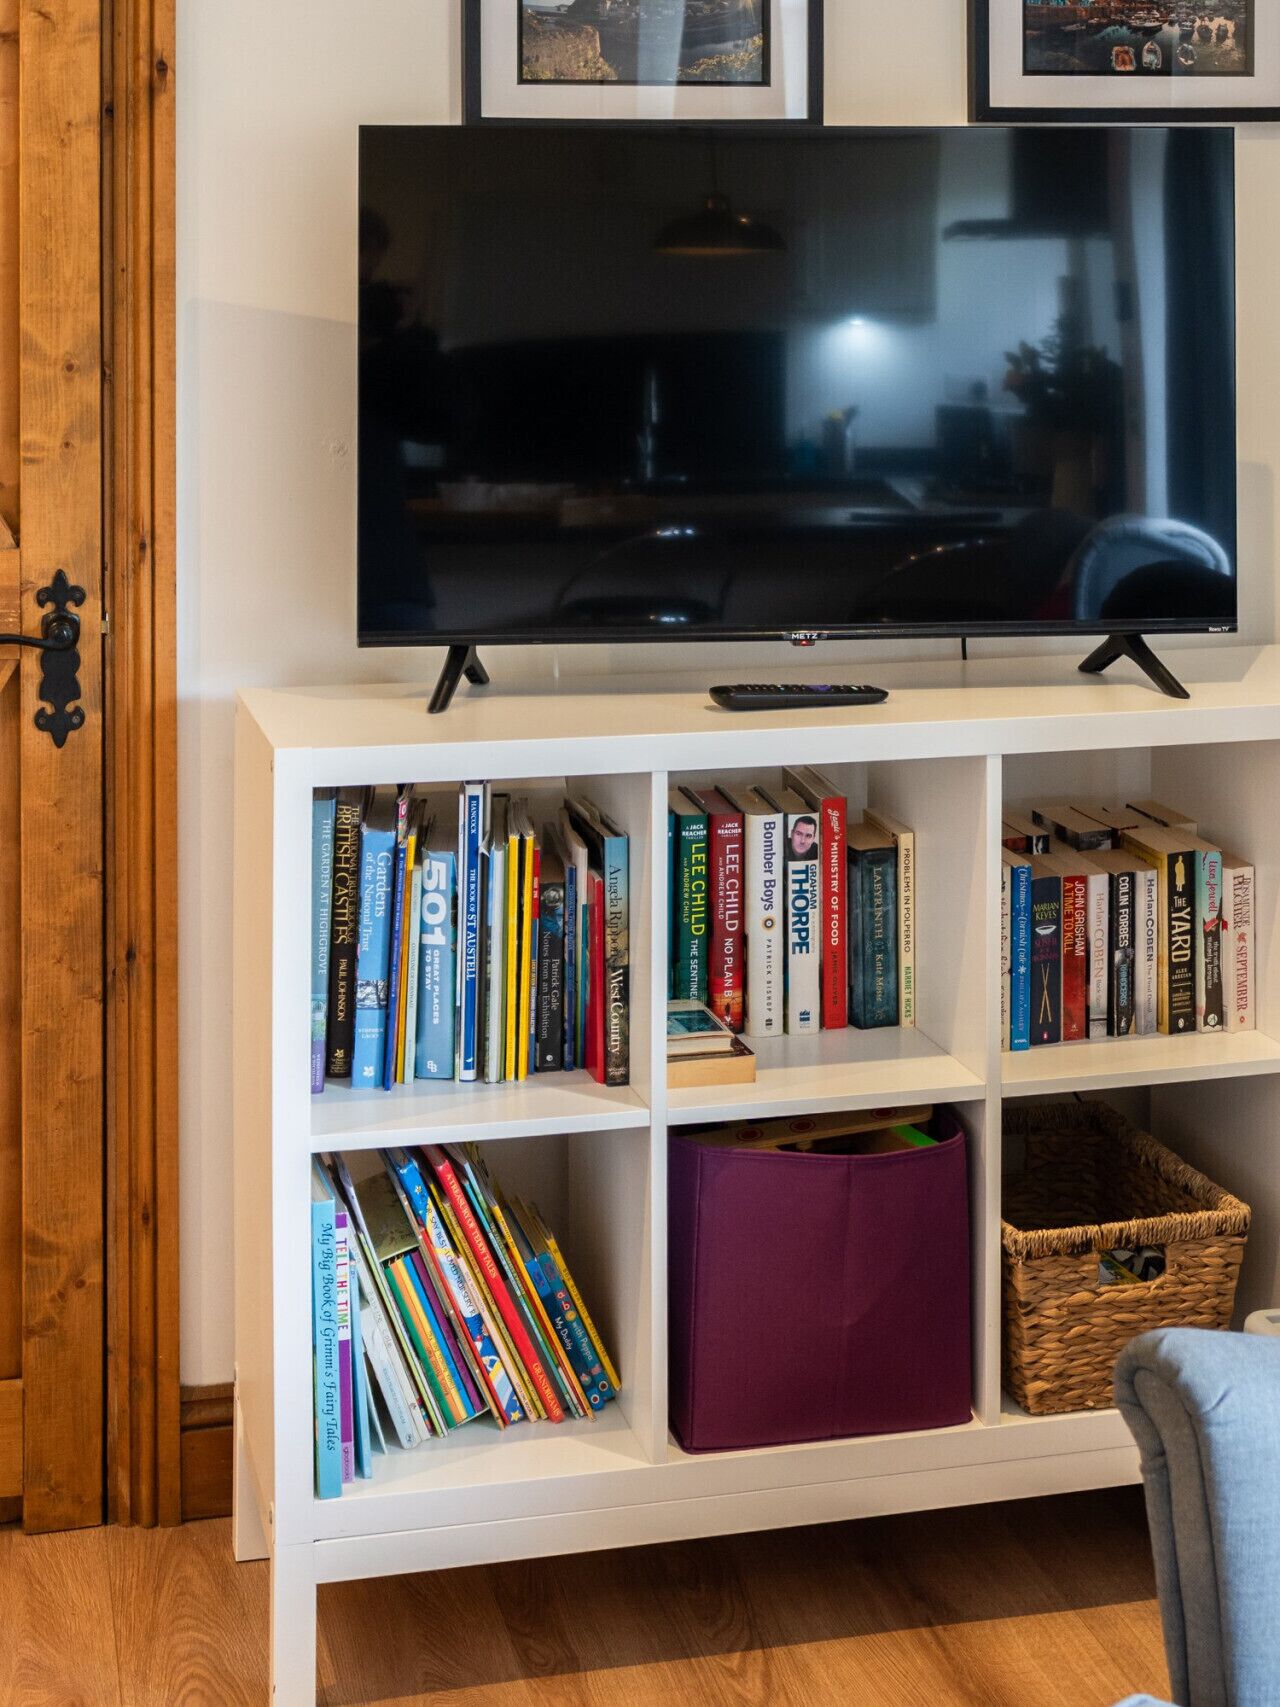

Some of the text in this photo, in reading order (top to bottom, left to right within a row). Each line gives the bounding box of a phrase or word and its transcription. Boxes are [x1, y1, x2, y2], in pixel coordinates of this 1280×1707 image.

[791, 632, 817, 640] METZ
[350, 806, 360, 825] THE
[828, 808, 842, 841] Jamie's
[334, 805, 351, 945] BRITISH CASTLES
[374, 852, 394, 918] Gardens
[608, 864, 622, 909] Angela
[690, 842, 706, 937] LEE CHILD
[725, 843, 739, 933] LEE CHILD
[759, 820, 776, 913] Bomber Boys
[809, 863, 818, 910] GRAHAM
[830, 842, 840, 892] MINISTRY
[1018, 868, 1028, 907] Christmas
[317, 819, 331, 975] THE GARDEN AT HIGHGROVE
[361, 852, 376, 952] of the National Trust
[422, 858, 447, 945] 501
[467, 913, 477, 929] ST
[468, 903, 475, 913] OF
[682, 900, 690, 924] CHILD
[791, 863, 810, 955] THORPE
[830, 893, 839, 911] OF
[904, 895, 911, 906] IN
[1033, 901, 1060, 913] MARIAN
[1035, 911, 1058, 921] KEYES
[1063, 881, 1073, 954] A TIME TO KILL
[1074, 880, 1085, 957] JOHN GRISHAM
[1119, 876, 1130, 949] COLIN FORBES
[1145, 878, 1155, 963] Harlan COBEN
[1173, 895, 1187, 908] THE
[1206, 880, 1219, 914] jewell
[1232, 874, 1245, 931] PILCHER
[1242, 877, 1253, 928] ROSAMUNDE
[691, 938, 699, 958] THE
[830, 913, 839, 946] FOOD
[873, 866, 884, 1002] LABYRINTH Kate Mosse
[903, 906, 911, 954] POLPERRO
[1018, 916, 1028, 948] Cornish
[1094, 892, 1105, 979] Harlan COBEN
[1171, 906, 1192, 964] YARD
[425, 949, 432, 965] TO
[466, 931, 477, 982] AUSTELL
[724, 938, 734, 998] NO PLAN B
[905, 966, 913, 997] HARRIET
[1236, 945, 1248, 1013] SEPTEMBER
[337, 958, 347, 1022] PAUL JOHNSON
[432, 949, 440, 1025] GREAT PLACES
[541, 931, 552, 1040] Notes from an Exhibition
[550, 958, 560, 1011] Patrick Gale
[611, 968, 623, 1001] West
[608, 1002, 622, 1056] Country
[432, 1216, 441, 1232] SAY
[447, 1176, 473, 1223] TREASURY
[465, 1219, 476, 1231] OF
[470, 1228, 488, 1255] TEDDY
[337, 1236, 350, 1332] TELL THE TIME
[483, 1252, 498, 1279] TALES
[321, 1223, 338, 1452] My Big Book of Grimm's Fairy Tales
[554, 1315, 563, 1330] My
[560, 1328, 573, 1351] Daddy
[571, 1321, 594, 1362] with Peppa
[532, 1361, 561, 1417] GRANDREAMS
